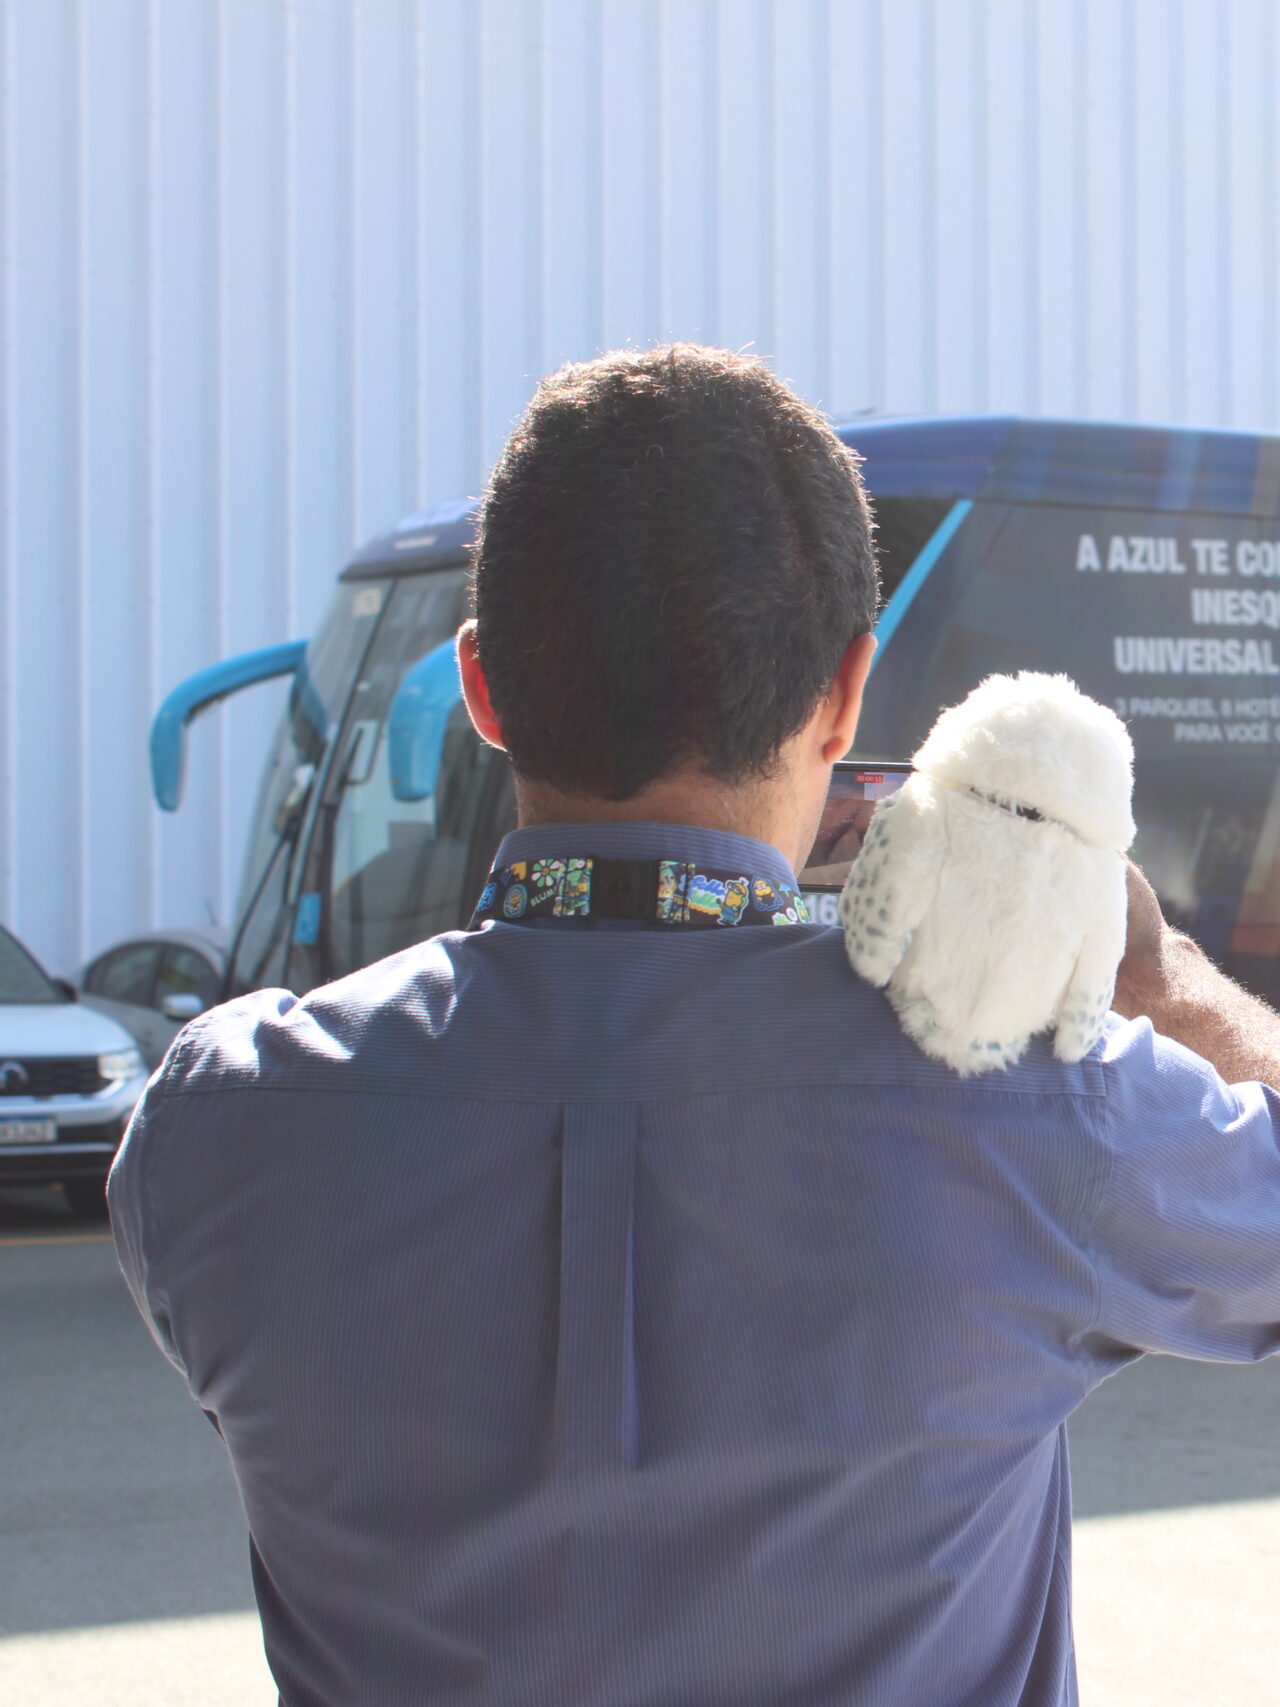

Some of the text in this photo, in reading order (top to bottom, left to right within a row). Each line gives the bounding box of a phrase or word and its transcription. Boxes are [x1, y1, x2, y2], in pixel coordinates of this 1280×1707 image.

[1077, 535, 1100, 571] A
[1108, 536, 1186, 573] AZUL
[1191, 540, 1229, 574] TE
[1114, 637, 1280, 675] UNIVERSAL
